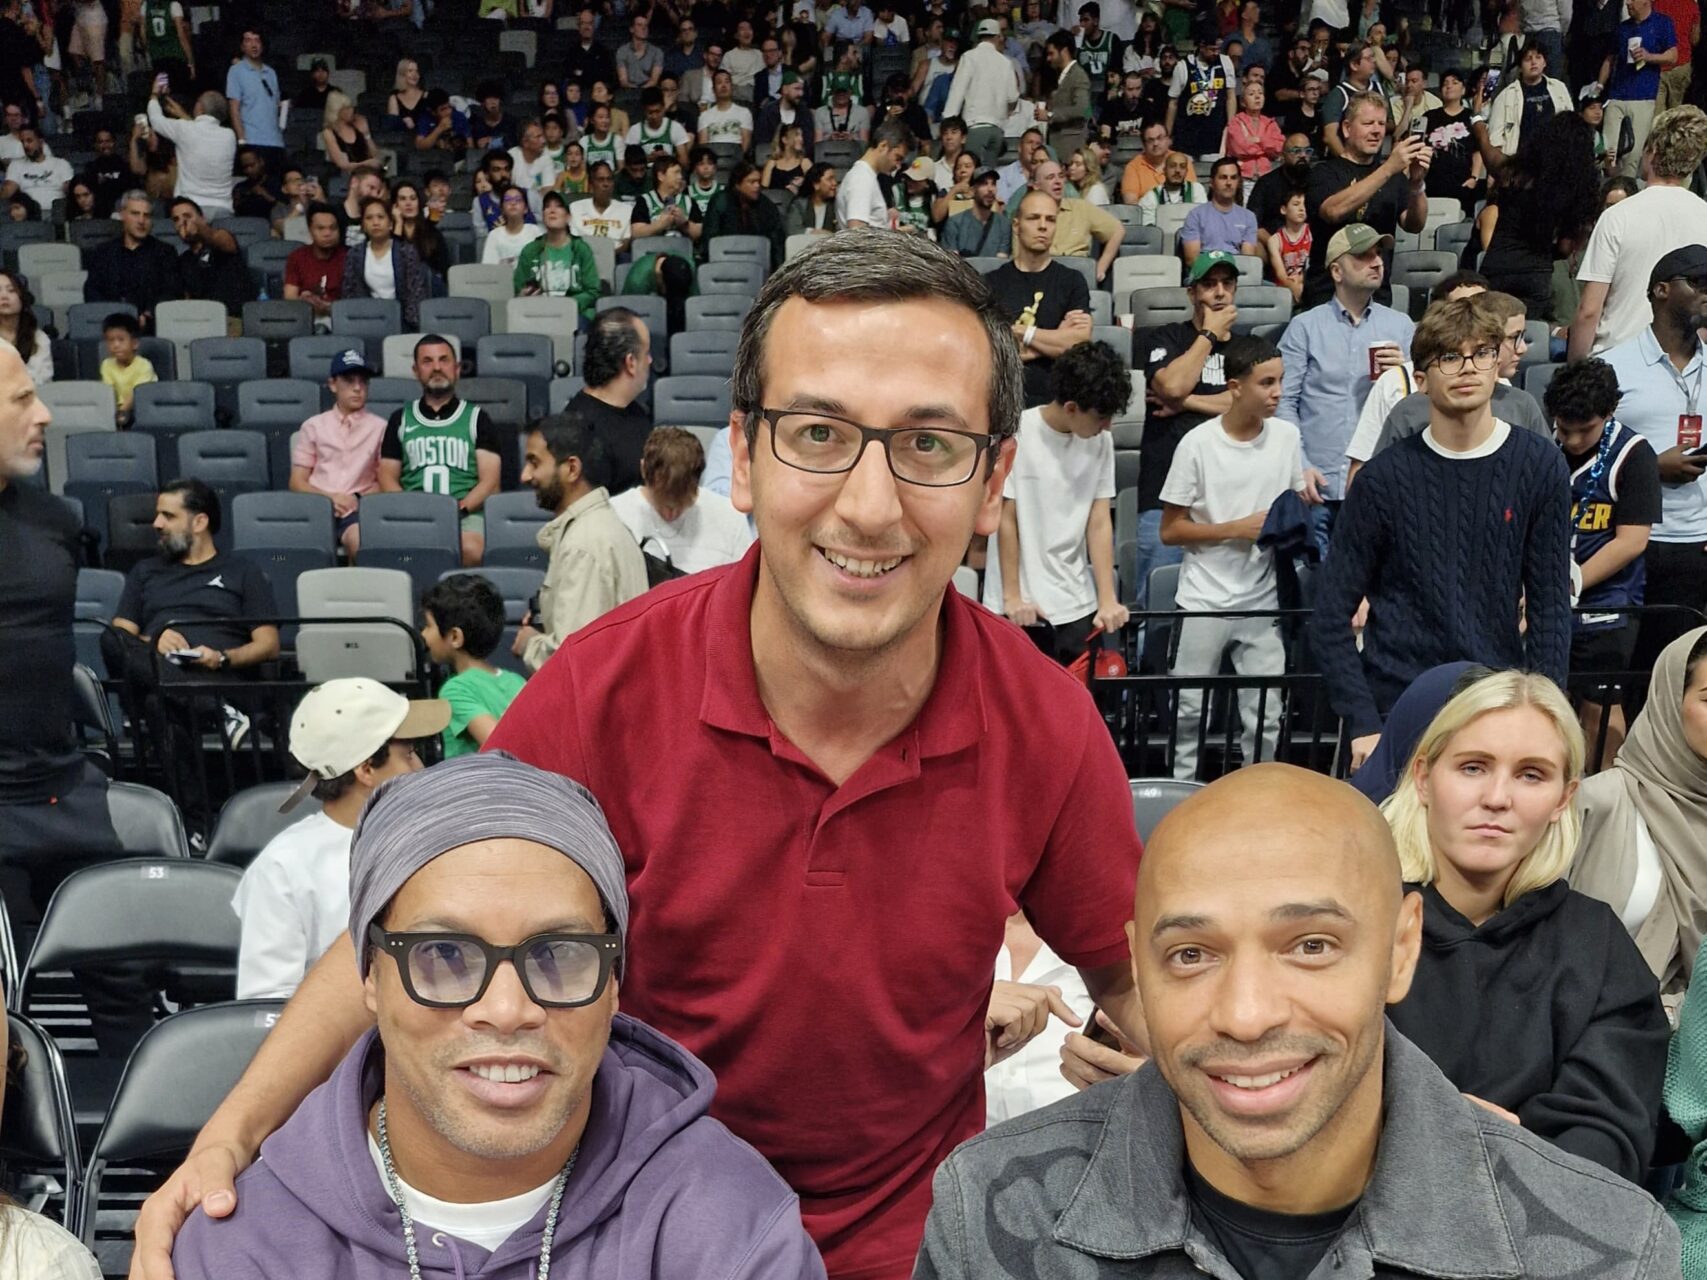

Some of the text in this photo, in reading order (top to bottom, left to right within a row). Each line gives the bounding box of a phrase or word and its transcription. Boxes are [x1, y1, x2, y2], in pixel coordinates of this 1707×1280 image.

[405, 435, 470, 471] BOSTON
[149, 866, 164, 879] 53
[264, 1012, 281, 1028] 5
